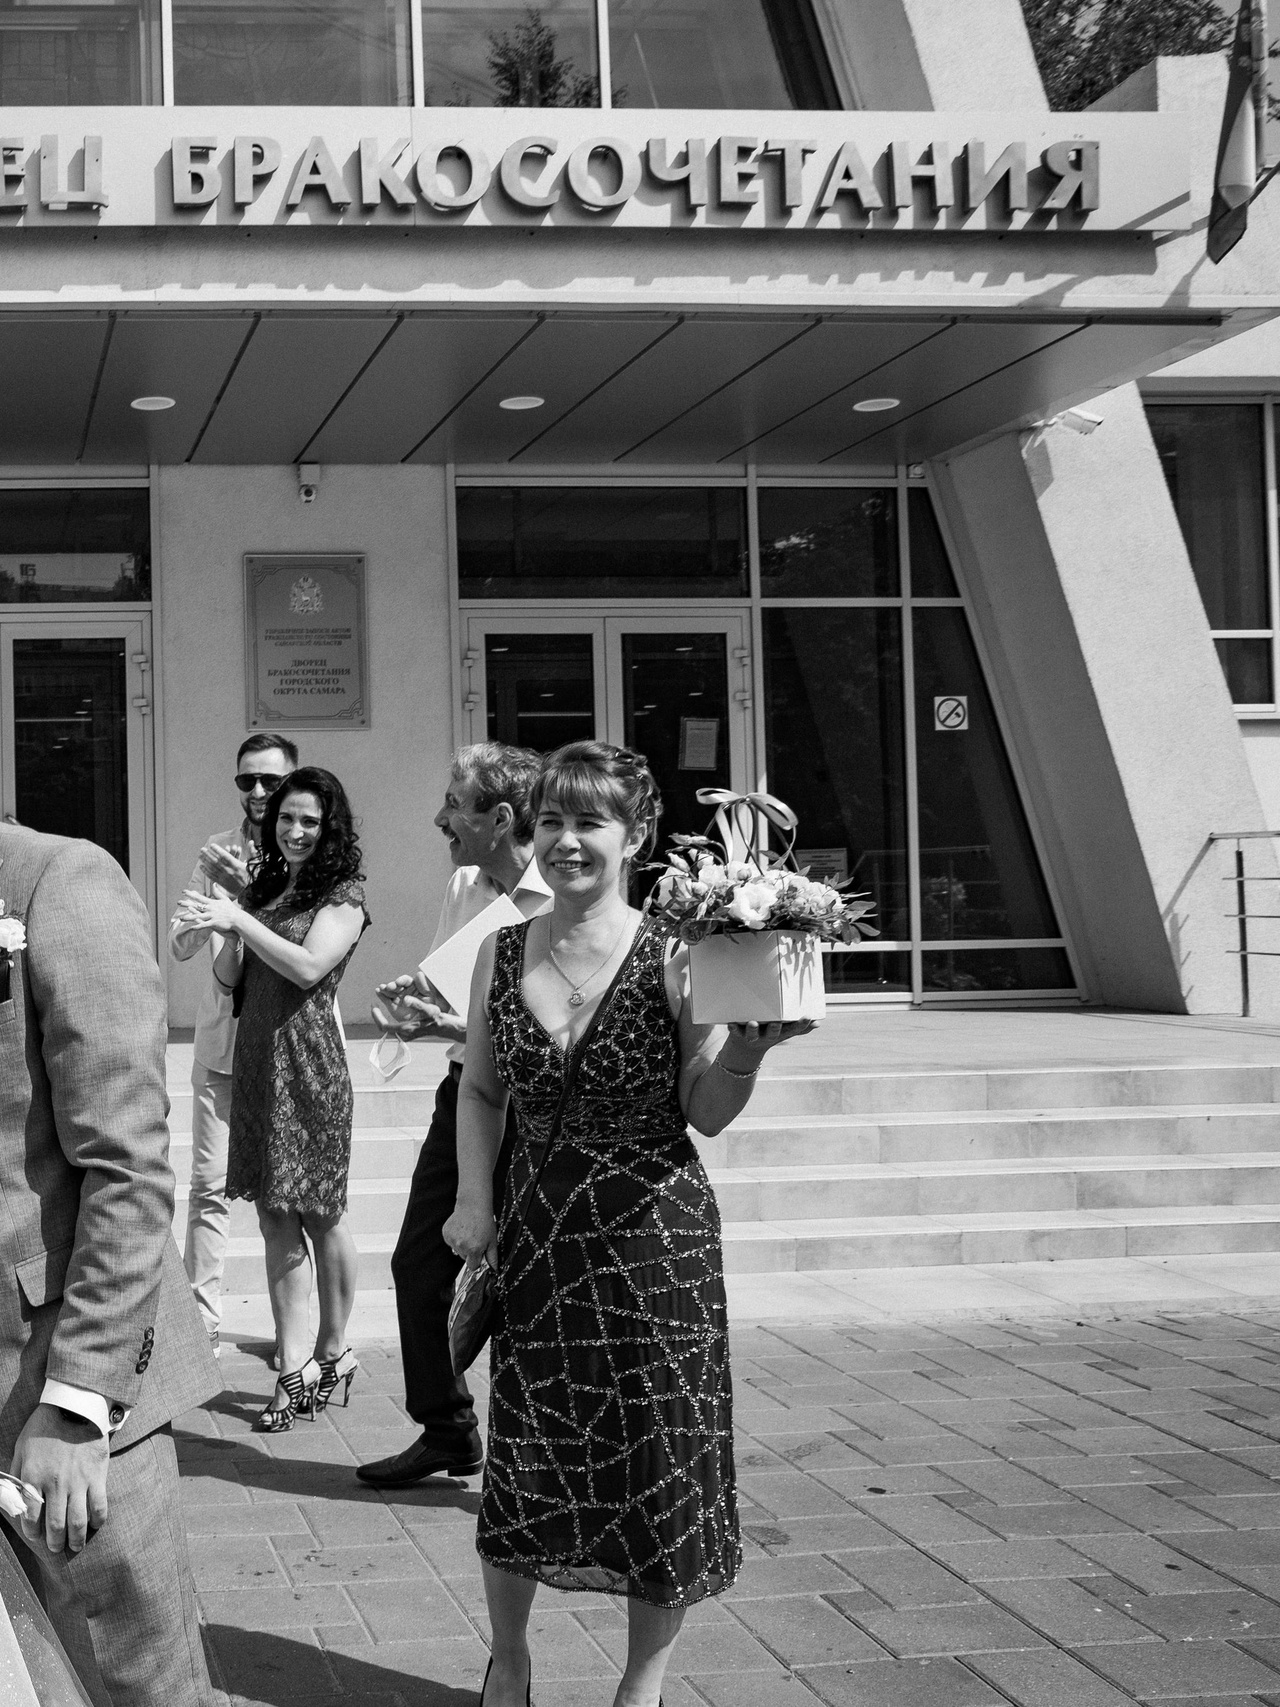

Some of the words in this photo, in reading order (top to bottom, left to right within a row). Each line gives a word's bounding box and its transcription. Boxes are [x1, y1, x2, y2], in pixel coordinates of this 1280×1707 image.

[170, 135, 1101, 213] БРАКОСОЧЕТАНИЯ
[291, 659, 327, 667] ДВОРЕЦ
[267, 668, 351, 676] БРАКОСОЧЕТАНИЯ
[280, 678, 340, 686] ГОРОДСКОГО
[309, 687, 346, 695] САМАРА
